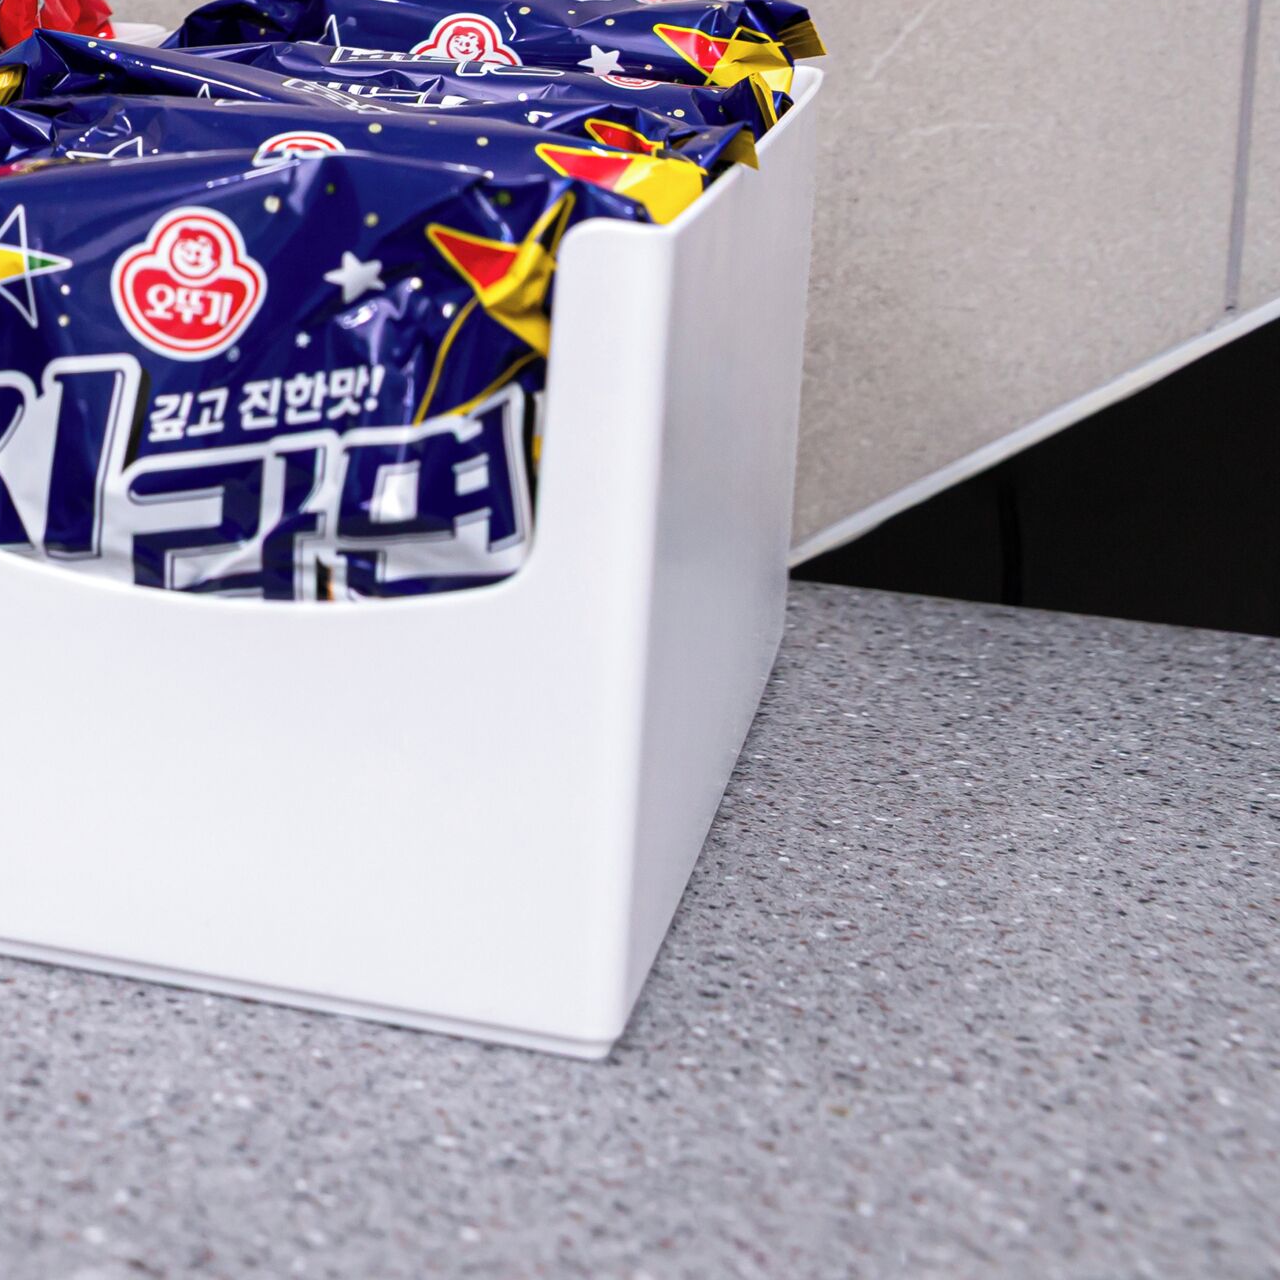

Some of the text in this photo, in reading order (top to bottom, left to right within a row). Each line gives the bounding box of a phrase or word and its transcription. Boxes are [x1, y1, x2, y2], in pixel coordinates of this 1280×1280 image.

[144, 283, 233, 328] 오뚜기
[148, 364, 386, 443] 깊고 진한맛!
